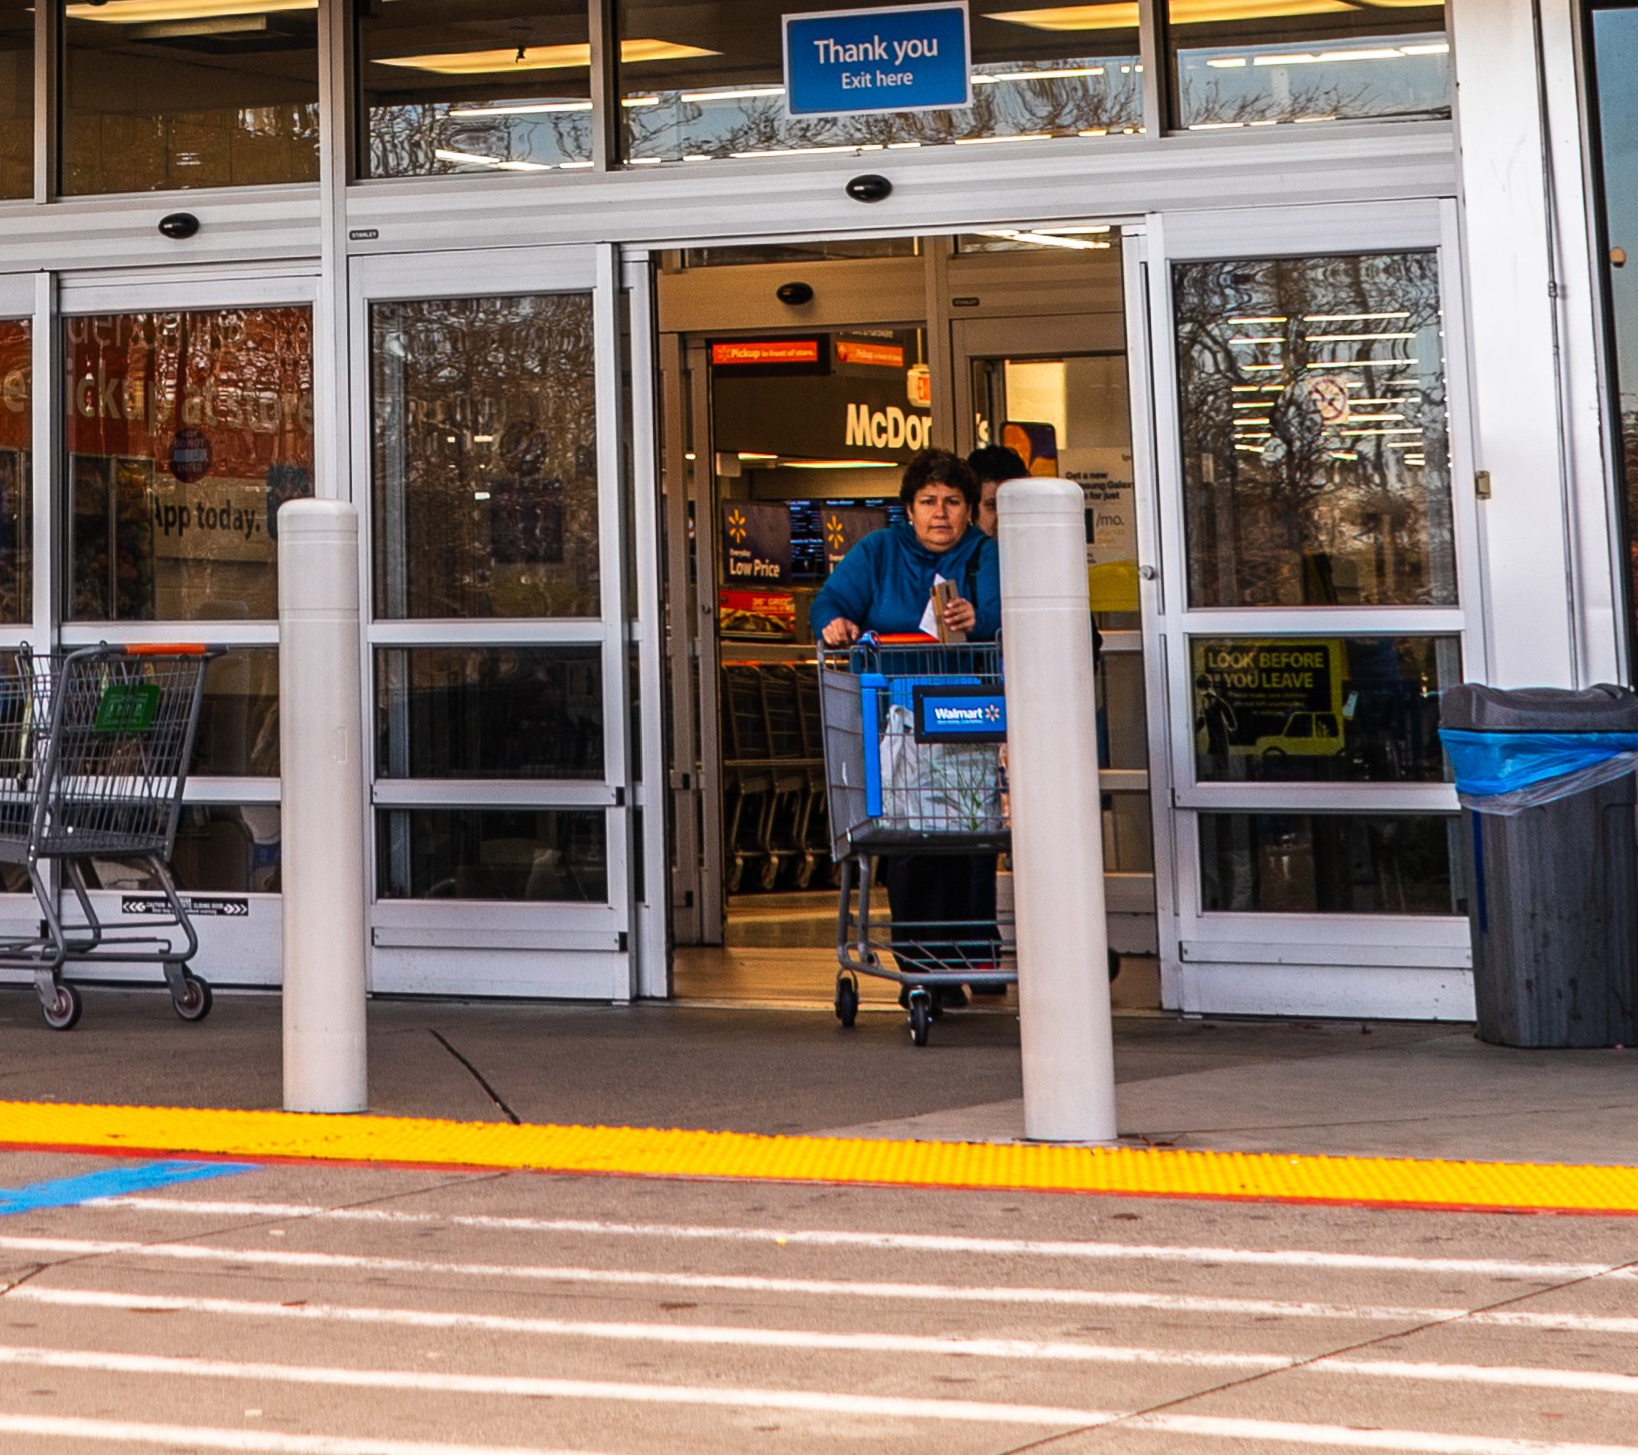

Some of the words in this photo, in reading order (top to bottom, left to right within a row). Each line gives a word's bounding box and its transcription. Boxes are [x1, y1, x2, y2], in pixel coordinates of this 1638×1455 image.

[813, 34, 889, 65] Thank
[892, 38, 938, 66] you
[841, 71, 873, 90] Exit
[876, 70, 914, 87] here
[196, 498, 261, 540] today.
[729, 558, 752, 576] Low
[753, 559, 781, 578] Price
[1208, 652, 1255, 668] LOOK
[1259, 652, 1325, 668] BEFORE
[1223, 672, 1259, 688] YOU
[1262, 672, 1314, 688] LEAVE
[935, 707, 983, 720] Walmart
